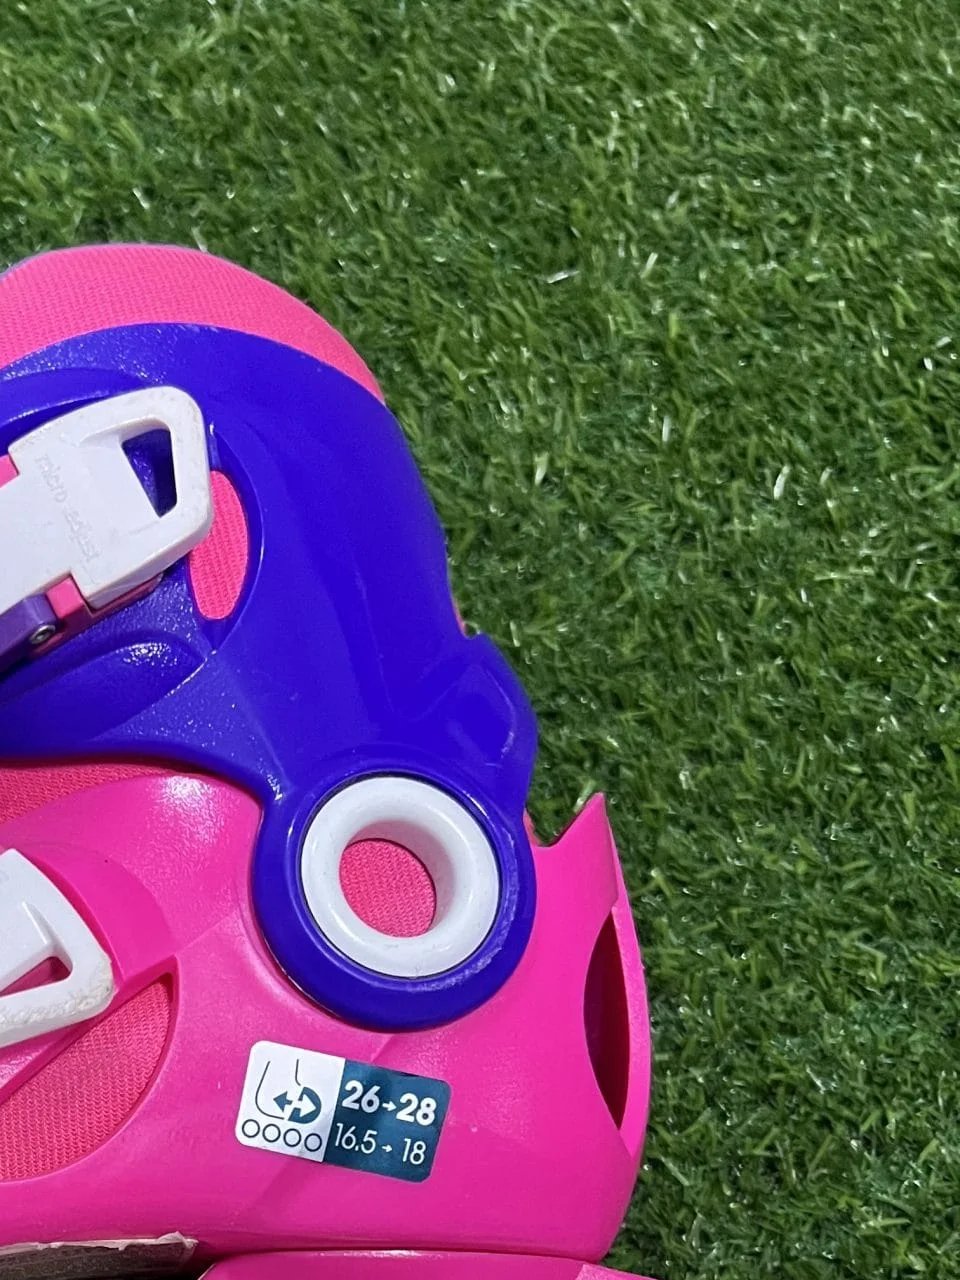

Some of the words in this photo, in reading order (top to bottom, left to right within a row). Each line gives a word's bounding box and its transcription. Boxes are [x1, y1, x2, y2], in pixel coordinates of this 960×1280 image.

[341, 1079, 381, 1113] 26
[395, 1092, 437, 1126] 28
[335, 1122, 378, 1154] 16.5
[401, 1138, 427, 1165] 18
